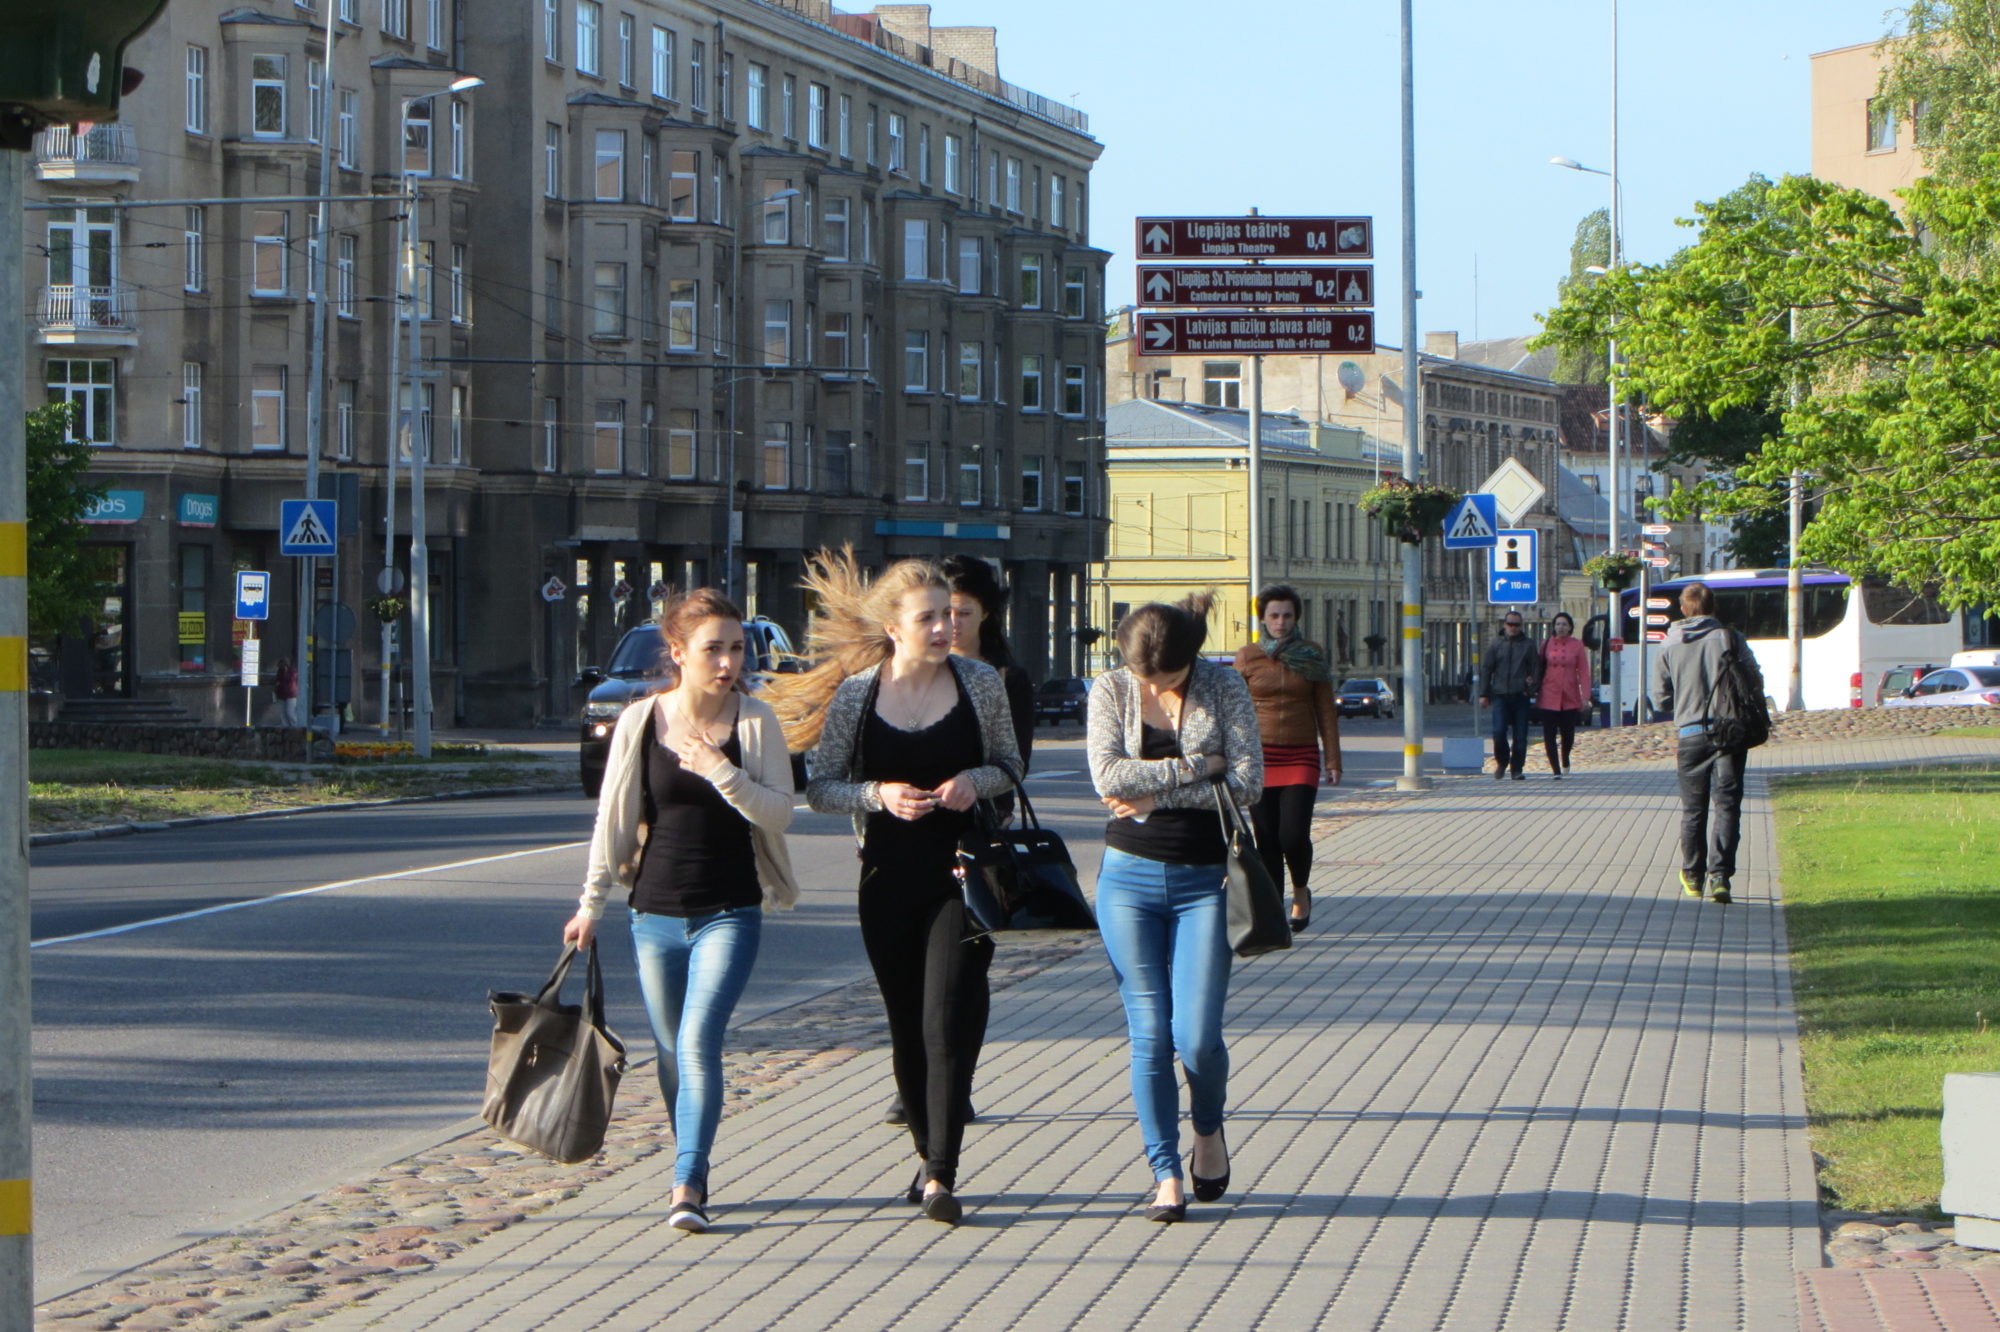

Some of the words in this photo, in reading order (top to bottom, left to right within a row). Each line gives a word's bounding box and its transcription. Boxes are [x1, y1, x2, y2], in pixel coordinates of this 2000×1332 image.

[1187, 222, 1241, 240] Liepājas
[1245, 222, 1290, 238] teātris
[1202, 243, 1235, 255] Liepāja
[1238, 243, 1275, 254] Theatre
[1306, 231, 1327, 250] 0,4
[1177, 270, 1210, 288] Liepājas
[1274, 270, 1313, 286] katedrāle
[1190, 291, 1228, 302] Cathedral
[1230, 291, 1239, 302] of
[1240, 291, 1254, 302] the
[1255, 291, 1272, 303] Holy
[1274, 291, 1300, 303] Trinity
[1315, 280, 1335, 298] 0,2
[1186, 319, 1227, 336] Latvijas
[1231, 318, 1266, 338] mūziķu
[1269, 318, 1303, 334] slavas
[1306, 318, 1332, 336] aleja
[1348, 325, 1365, 343] 0,2
[1187, 339, 1201, 350] The
[1203, 339, 1231, 350] Latvian
[1234, 338, 1274, 349] Musicians
[1276, 338, 1331, 349] Walk-of-Fame
[187, 498, 213, 519] Drogas
[1510, 581, 1522, 590] 110
